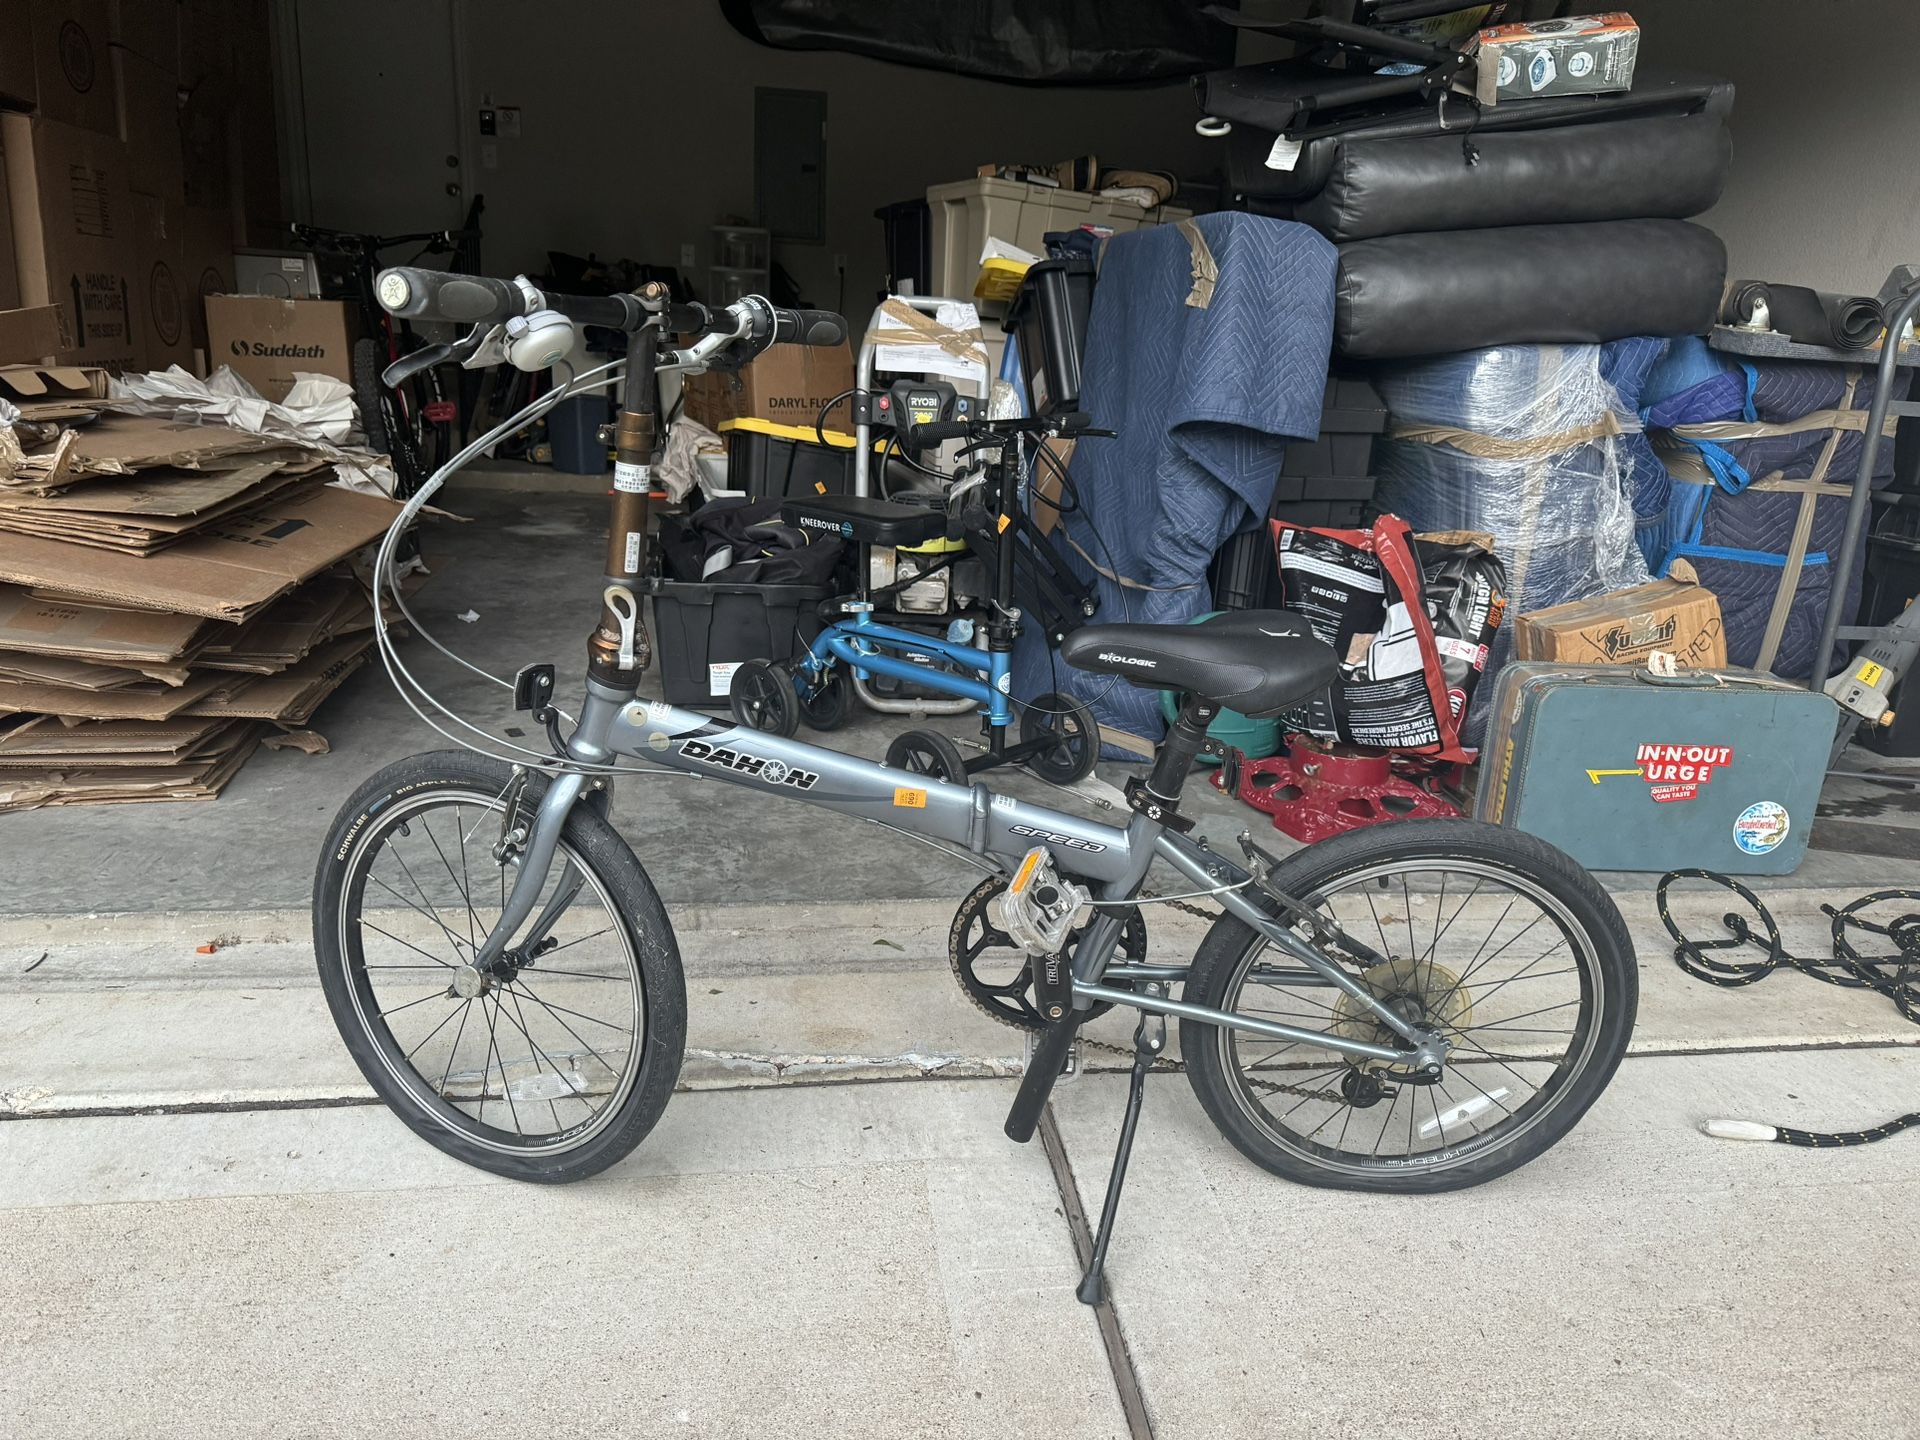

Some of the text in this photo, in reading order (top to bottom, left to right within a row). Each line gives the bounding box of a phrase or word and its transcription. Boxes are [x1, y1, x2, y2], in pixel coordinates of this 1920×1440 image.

[85, 272, 115, 291] HANDLE
[83, 293, 123, 312] WITH CARE
[252, 343, 326, 359] Suddath
[769, 397, 844, 409] DARYL FLOD
[911, 397, 938, 407] RYOBI
[800, 516, 841, 533] KNEEROVER
[1468, 606, 1487, 639] LIGHT
[1605, 614, 1677, 660] Suit
[1449, 640, 1459, 656] USES
[1616, 641, 1673, 658] RACING EQUIPMENT
[1098, 652, 1157, 668] BIOLOGIC
[1387, 723, 1410, 733] SECRET
[1410, 721, 1423, 729] THE
[1416, 725, 1436, 733] WOOD
[1422, 716, 1435, 726] IT'S
[1400, 730, 1439, 747] FLAVOR
[679, 739, 819, 790] DAHON
[1647, 762, 1709, 781] URGE
[396, 785, 414, 795] BIG
[415, 780, 447, 788] APPLE
[1652, 786, 1680, 794] QUALITY
[337, 813, 369, 861] SCHWALBE
[1009, 824, 1107, 853] SPEED
